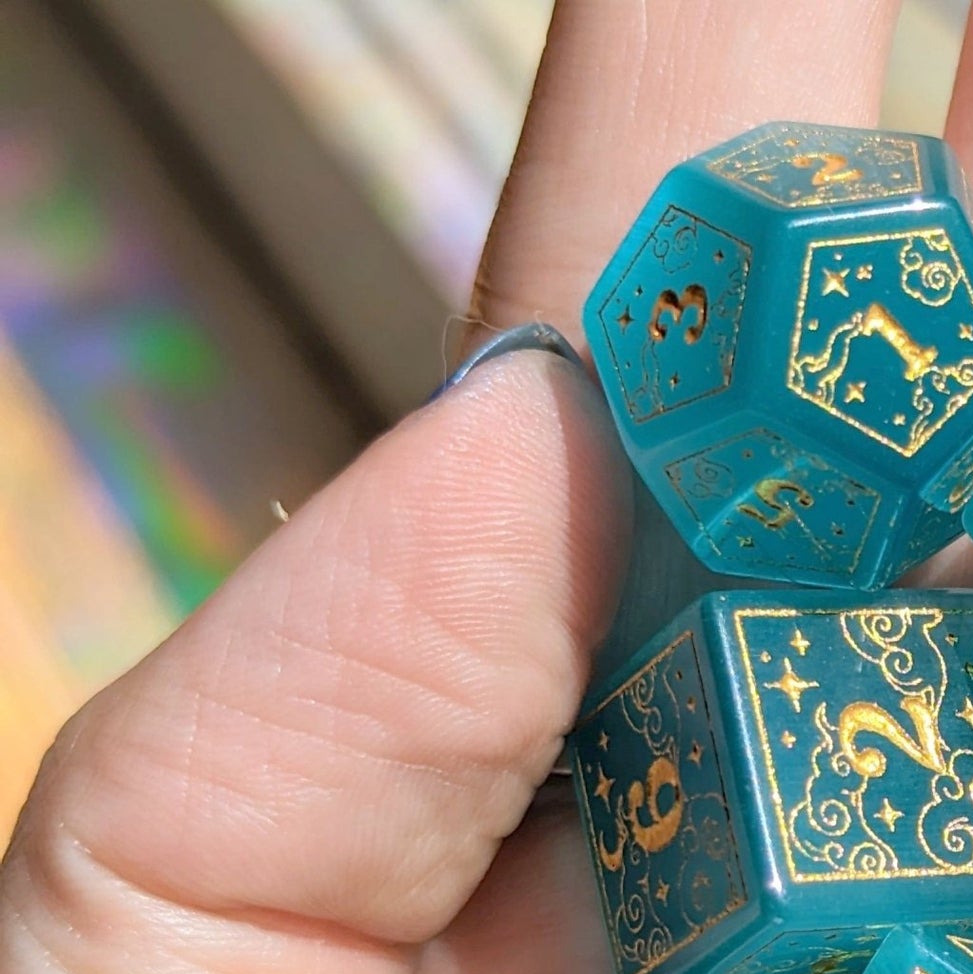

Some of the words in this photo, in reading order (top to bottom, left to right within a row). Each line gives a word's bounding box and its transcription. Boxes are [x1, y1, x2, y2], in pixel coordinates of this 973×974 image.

[792, 153, 864, 187] 2
[648, 284, 709, 346] 3
[863, 303, 939, 382] 1
[736, 477, 815, 531] 5
[839, 696, 948, 779] 2
